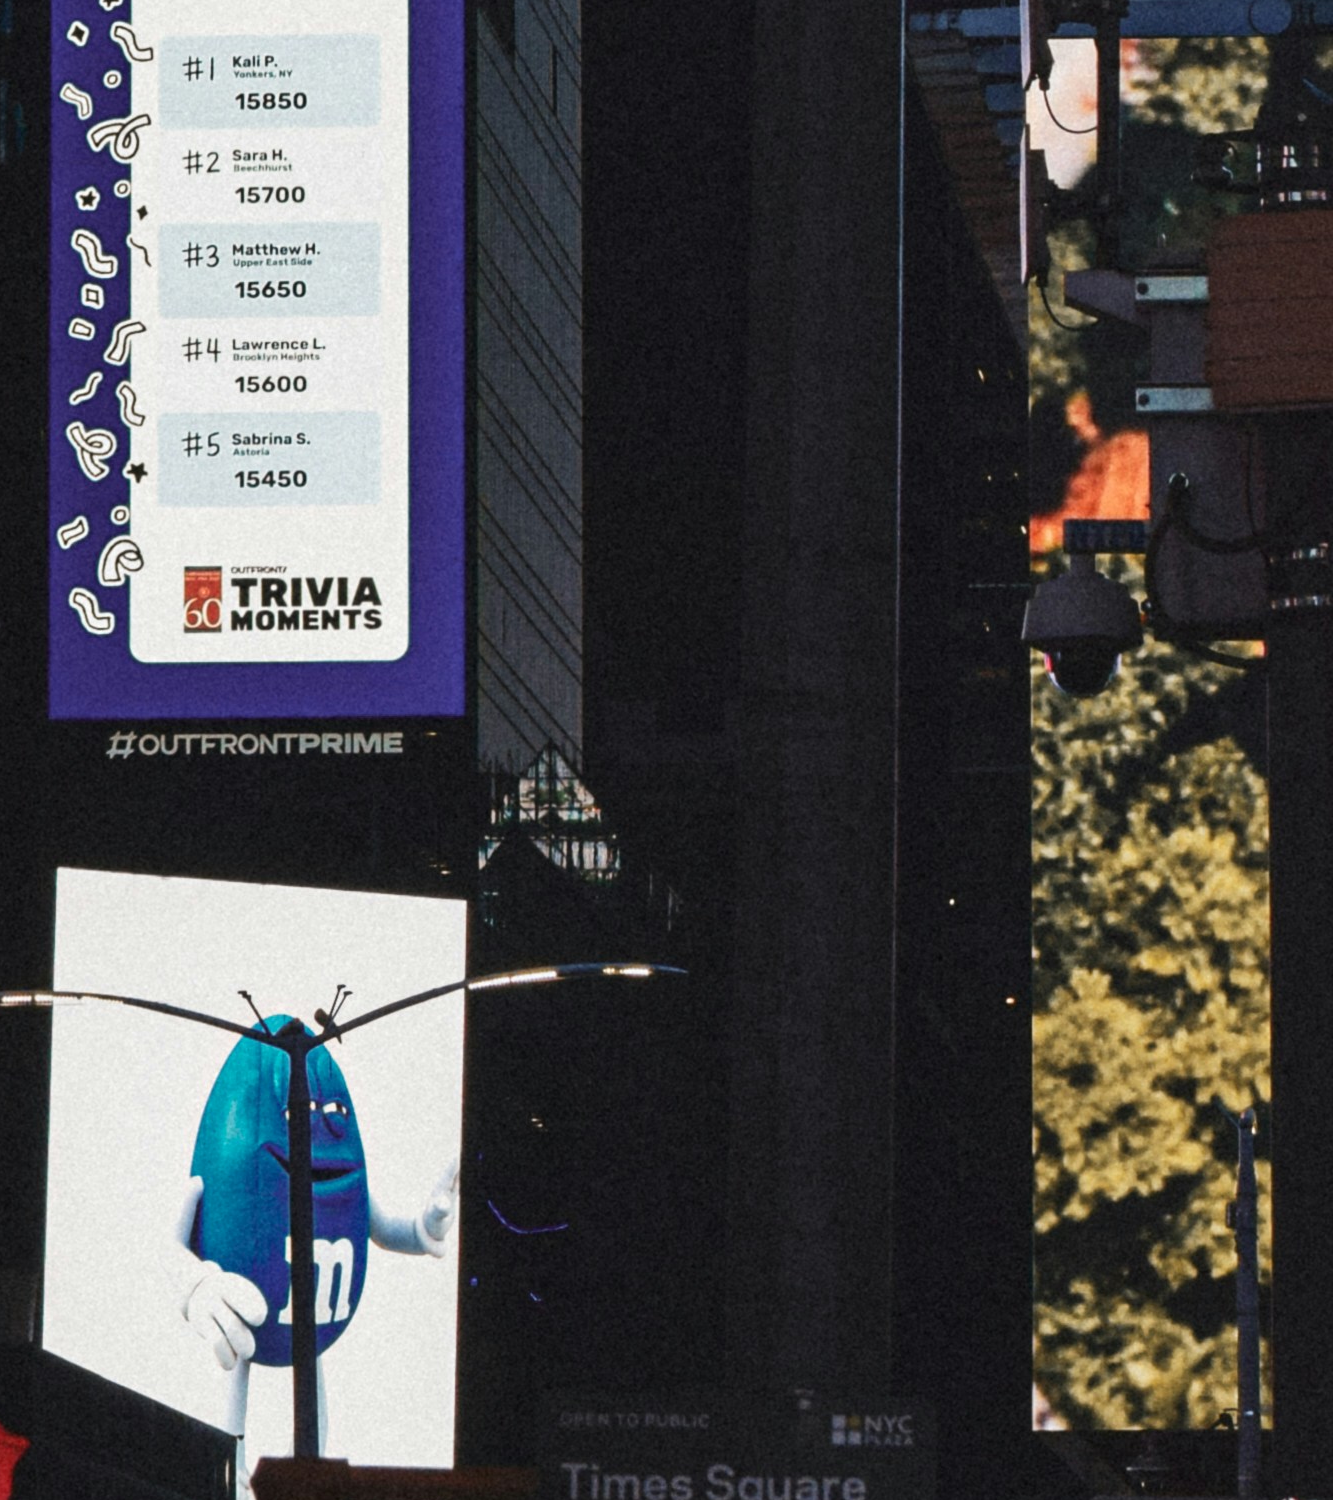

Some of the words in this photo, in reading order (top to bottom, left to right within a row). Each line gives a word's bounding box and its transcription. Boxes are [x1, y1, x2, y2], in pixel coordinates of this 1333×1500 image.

[183, 55, 216, 82] #1
[233, 54, 262, 69] Kali
[265, 54, 278, 69] P.
[278, 70, 293, 79] NY
[235, 92, 307, 111] 15850
[183, 149, 220, 176] #2
[233, 148, 266, 163] Sara
[270, 148, 288, 162] H.
[235, 185, 306, 205] 15700
[183, 242, 221, 269] #3
[232, 243, 300, 257] Matthew
[305, 243, 321, 256] H.
[232, 257, 262, 268] Upper
[265, 257, 287, 267] East
[290, 257, 313, 267] Side
[235, 280, 307, 299] 15650
[183, 336, 221, 363] #4
[232, 338, 308, 352] Lawrence
[313, 337, 327, 351] L.
[232, 352, 275, 363] Brooklyn
[278, 352, 321, 363] Heights
[235, 375, 307, 394] 15600
[183, 432, 221, 458] #5
[232, 432, 293, 447] Sabrina
[296, 432, 312, 446] S.
[232, 447, 271, 457] Astoria
[235, 470, 307, 489] 15450
[184, 598, 222, 629] 60
[231, 577, 383, 608] TRIVIA
[231, 609, 383, 632] MOMENTS
[106, 731, 404, 759] #OUTFRONTPRIME
[645, 1413, 710, 1429] PUBLIC
[864, 1414, 914, 1435] NYC
[561, 1462, 693, 1500] Times
